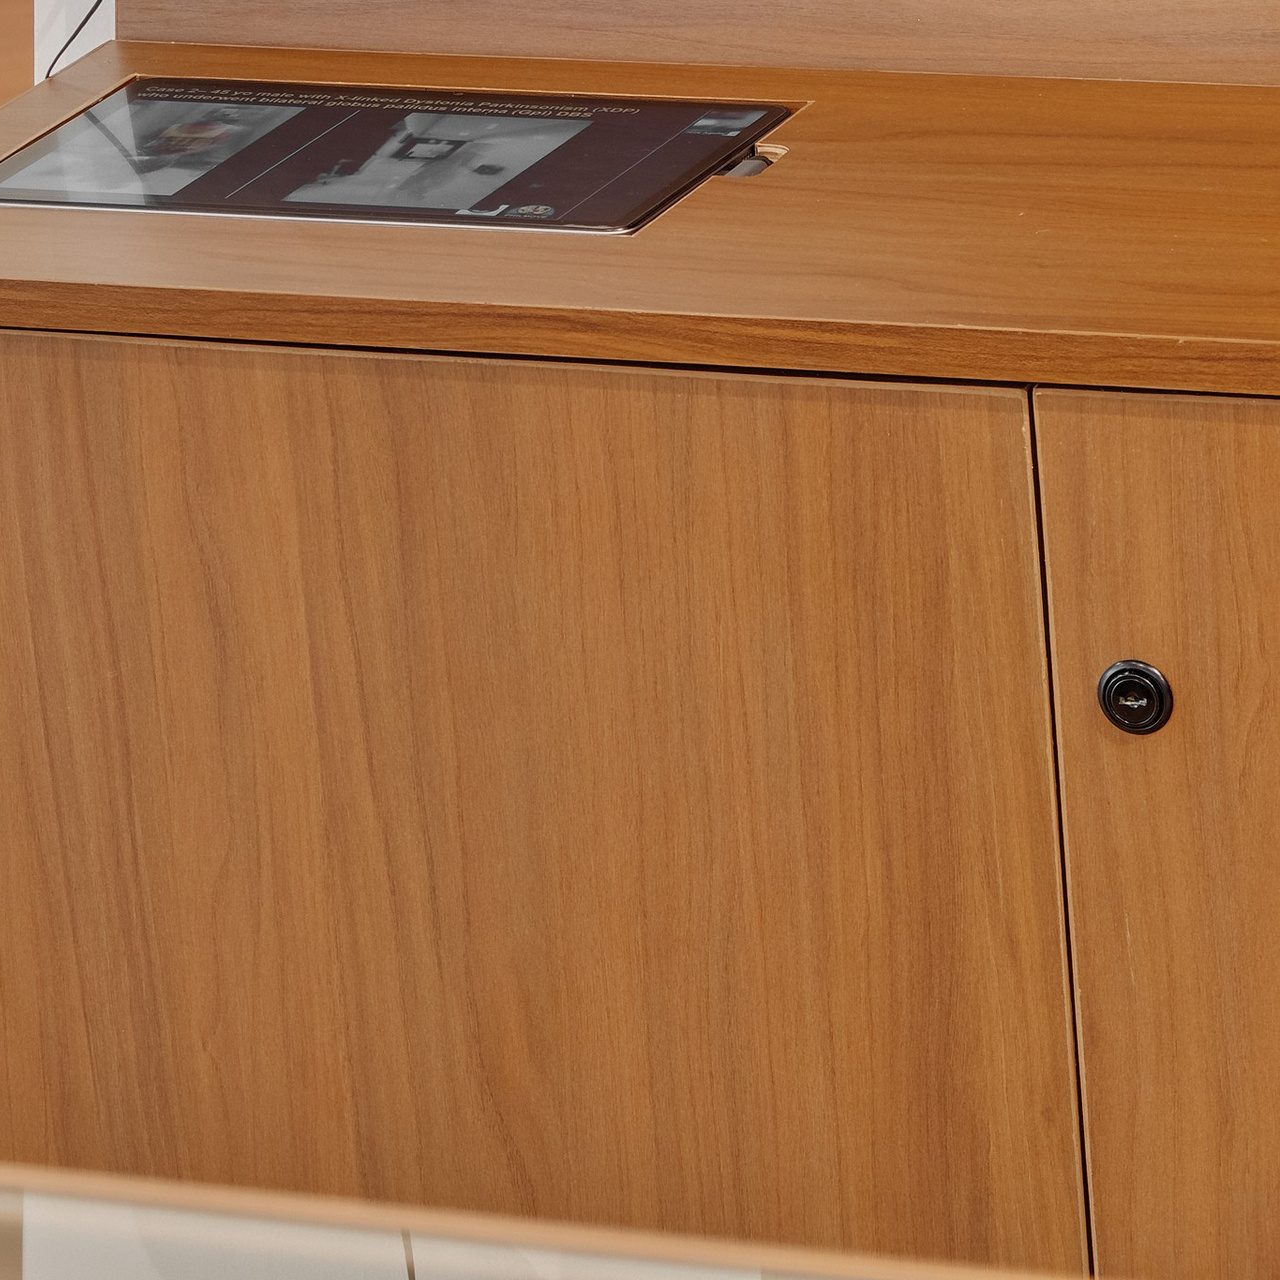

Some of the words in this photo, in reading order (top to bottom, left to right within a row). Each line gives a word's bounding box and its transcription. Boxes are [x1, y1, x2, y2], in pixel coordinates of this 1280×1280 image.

[173, 93, 257, 102] underwent
[259, 97, 324, 106] bilateral
[325, 101, 381, 109] globus
[382, 103, 448, 111] pallidus
[334, 95, 401, 103] X-linked
[403, 98, 474, 107] Dystonia
[478, 101, 589, 112] Parkinsonism
[592, 107, 640, 115] (XDP)
